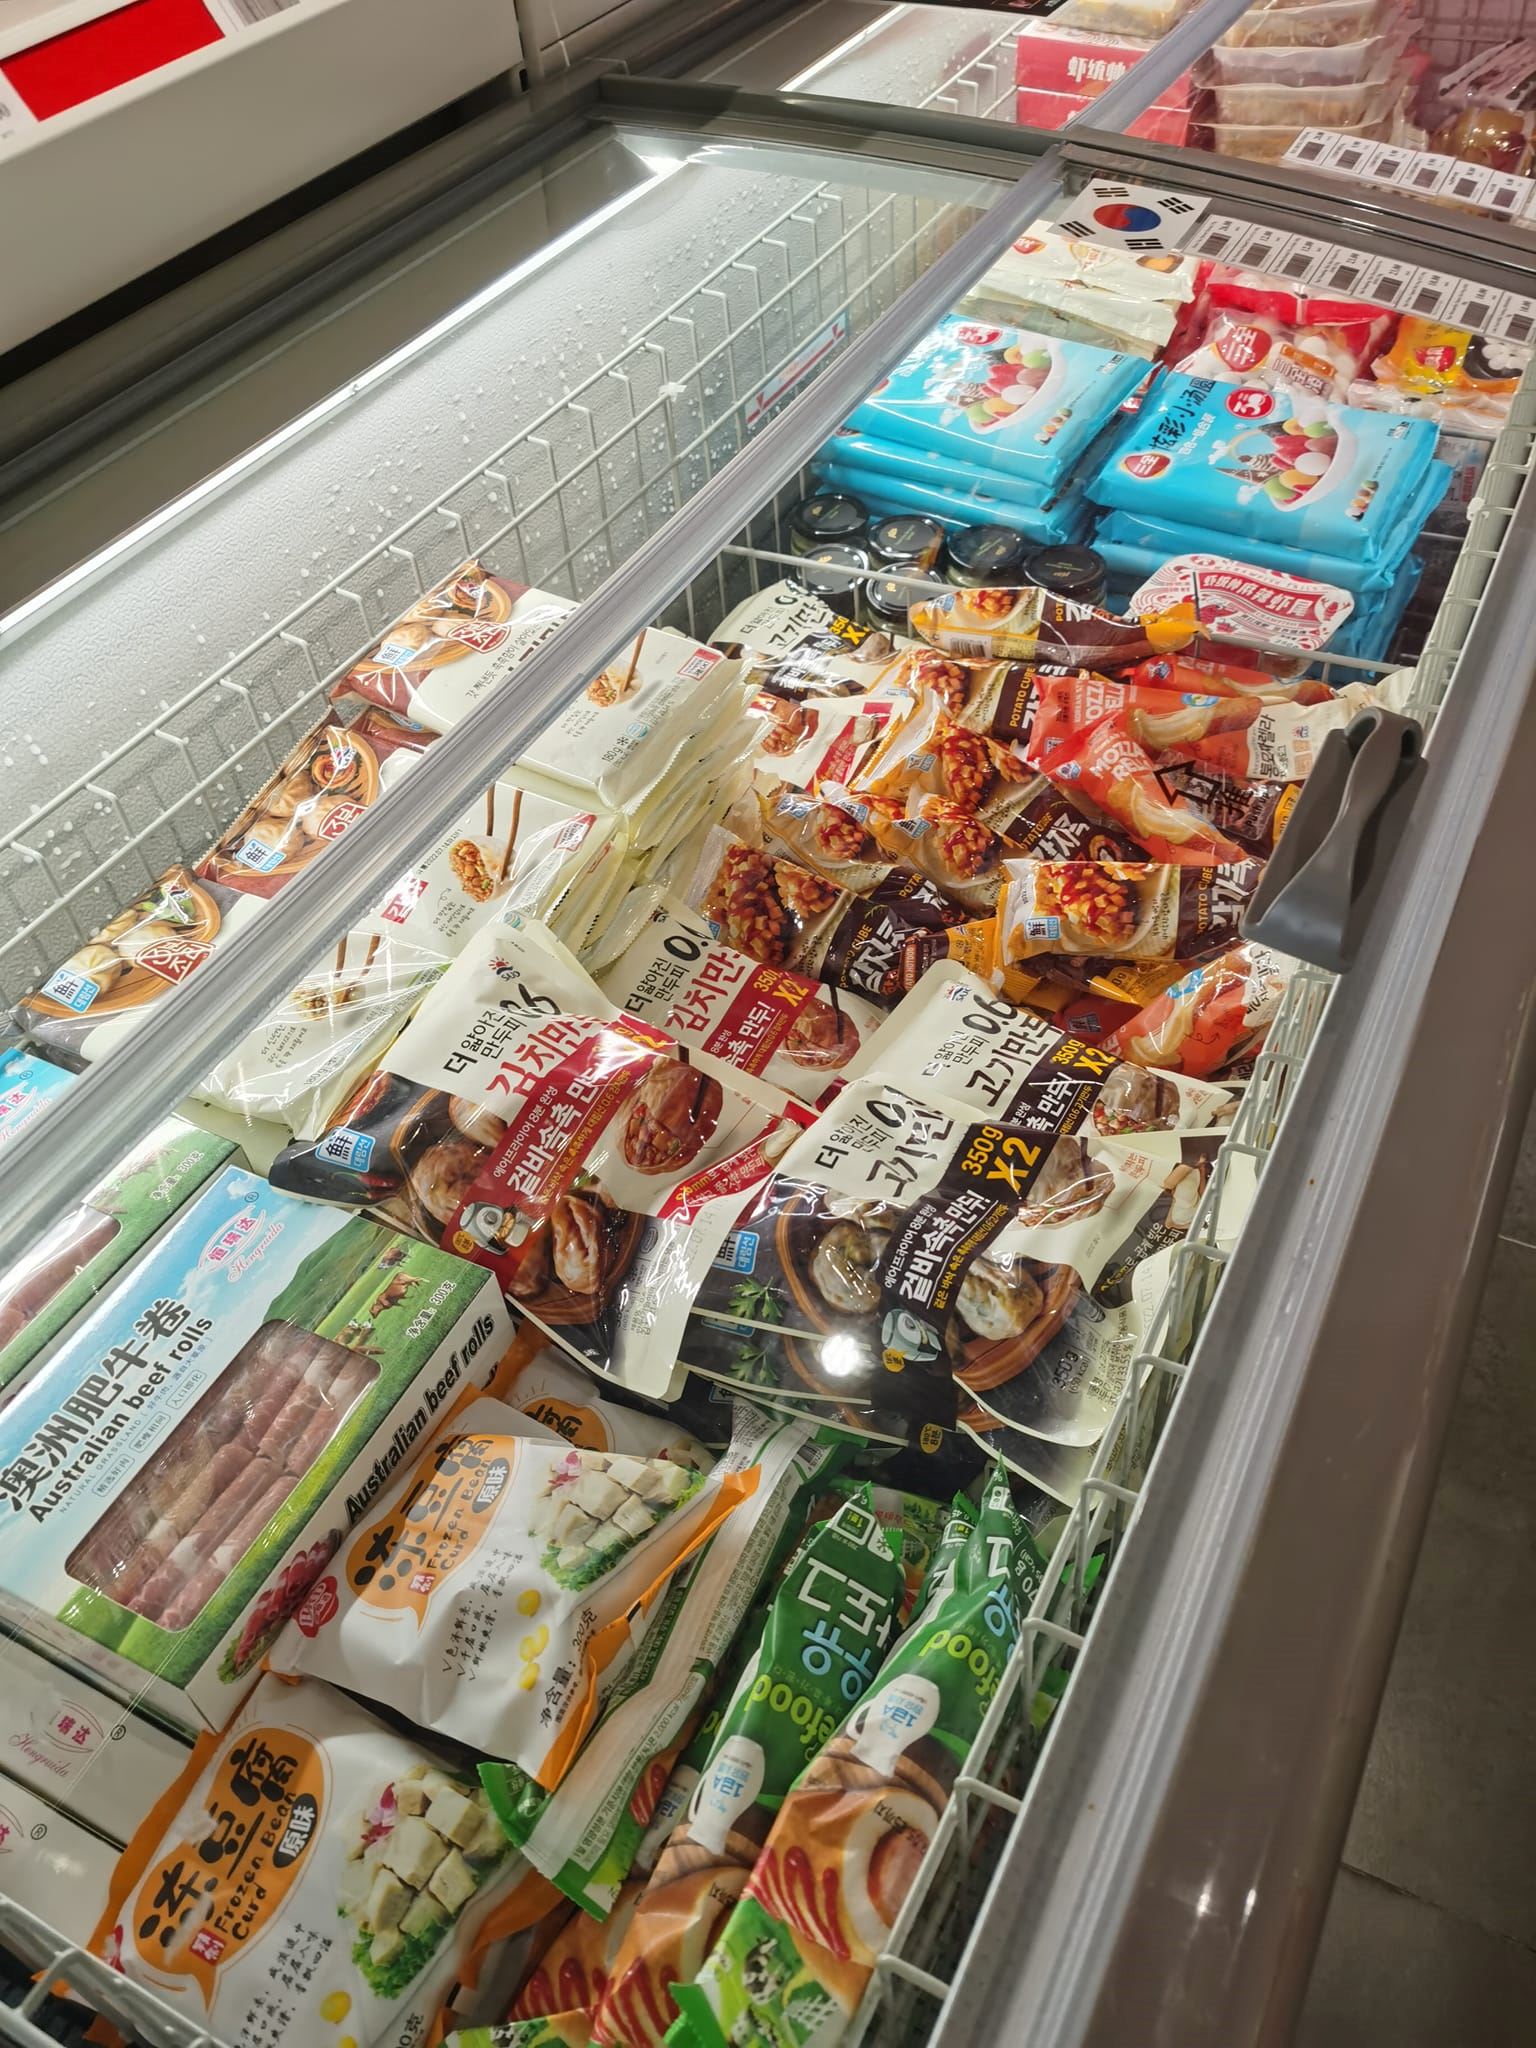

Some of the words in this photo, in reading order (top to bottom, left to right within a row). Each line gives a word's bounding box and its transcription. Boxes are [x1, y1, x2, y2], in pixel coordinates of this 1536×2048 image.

[1131, 454, 1159, 475] 三全
[1009, 690, 1027, 728] POTATO
[1023, 666, 1036, 691] CUBE
[602, 746, 624, 763] 180g
[1217, 783, 1254, 823] 推
[632, 953, 677, 999] 얇아진
[650, 961, 694, 1006] 만두피
[770, 973, 809, 1012] X2
[621, 986, 653, 1018] 더
[734, 996, 780, 1043] 만두!
[955, 982, 1020, 1047] 0.6
[457, 1003, 510, 1058] 얇아진
[477, 1012, 528, 1065] 만두피
[714, 1026, 733, 1045] 완성
[951, 1029, 991, 1071] 만두피
[1050, 1032, 1086, 1070] 350g
[440, 1044, 478, 1082] 더
[1071, 1038, 1117, 1084] X2
[526, 1101, 548, 1124] 8분
[536, 1083, 562, 1109] 완성
[1012, 1099, 1033, 1120] 완성
[1032, 1068, 1084, 1121] 만두!
[325, 1129, 354, 1165] 鮮
[351, 1135, 374, 1172] 대림선
[484, 1119, 542, 1180] 에어프라이어
[492, 1095, 595, 1201] 겉바속촉
[828, 1108, 873, 1155] 얇아진
[951, 1118, 1012, 1181] 350g
[737, 1152, 768, 1179] 만두피
[809, 1135, 851, 1176] 더
[976, 1124, 1051, 1201] X2
[908, 1212, 930, 1234] 8분
[918, 1200, 939, 1220] 완성
[206, 1210, 258, 1266] 恒瑞达
[222, 1215, 287, 1287] Hengruida
[736, 1236, 756, 1273] 대림선
[869, 1227, 931, 1291] 에어프라이어
[884, 1212, 980, 1312] 겉바속촉
[947, 1183, 992, 1229] 만두!
[1131, 1235, 1155, 1260] 곱게
[1144, 1219, 1168, 1244] 빚은
[937, 1269, 959, 1291] 바삭
[947, 1253, 968, 1274] 속은
[429, 1277, 458, 1307] 300克
[169, 1370, 203, 1407] 入口即化
[1048, 1347, 1081, 1390] 350g
[0, 1286, 193, 1517] 澳洲肥牛卷
[25, 1405, 132, 1524] Australian
[121, 1358, 172, 1413] beef
[164, 1310, 215, 1364] rolls
[344, 1410, 425, 1526] Australian
[424, 1358, 463, 1413] beef
[457, 1313, 496, 1362] rolls
[132, 1412, 168, 1452] 肥瘦相间
[58, 1472, 96, 1514] NATURAL
[94, 1417, 143, 1472] GRASSLAND
[476, 1461, 510, 1507] 原味
[351, 1410, 494, 1612] 冻豆腐
[425, 1503, 467, 1573] Frozen
[459, 1453, 492, 1504] Bean
[438, 1526, 470, 1574] Curd
[567, 1604, 602, 1652] 300克
[651, 1715, 671, 1739] 2,000
[664, 1701, 680, 1719] kcal
[3, 1726, 78, 1780] Hengruida
[129, 1727, 303, 1968] 冻豆腐
[274, 1799, 322, 1861] 原味
[212, 1850, 267, 1934] Frozen
[257, 1787, 300, 1850] Bean
[227, 1881, 272, 1943] Curd
[279, 1927, 320, 1989] 层层入味
[291, 1933, 334, 1998] 香飘四溢
